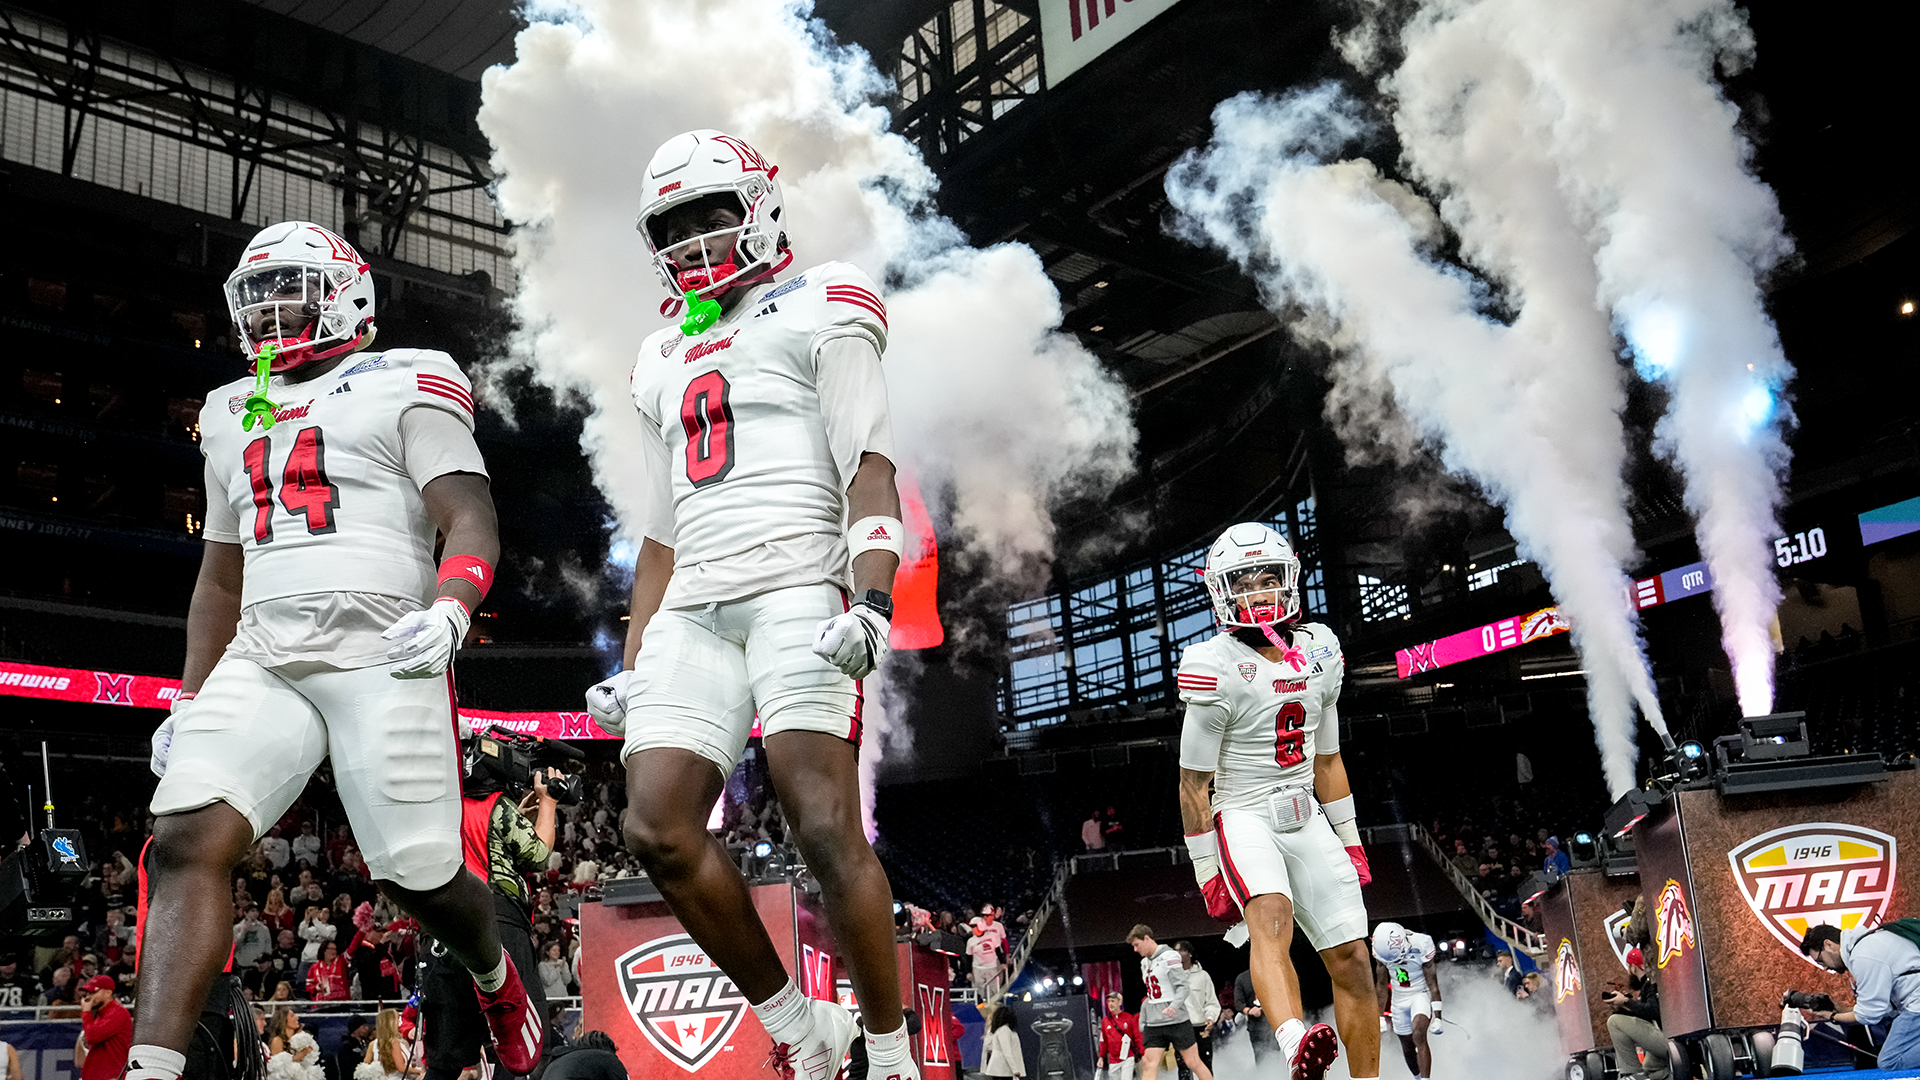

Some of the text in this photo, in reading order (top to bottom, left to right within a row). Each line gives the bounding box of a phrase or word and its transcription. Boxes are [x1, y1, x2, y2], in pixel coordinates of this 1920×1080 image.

[684, 329, 740, 364] Miami
[680, 368, 736, 490] 0
[243, 425, 341, 546] 14
[1774, 527, 1827, 568] 5:10
[1682, 570, 1704, 590] QTR
[1272, 676, 1309, 693] Miami
[1275, 701, 1307, 768] 6
[1793, 845, 1832, 860] 1946
[1753, 867, 1886, 910] MAC
[670, 954, 705, 968] 1946
[0, 986, 23, 1007] 78
[632, 975, 746, 1013] MAC
